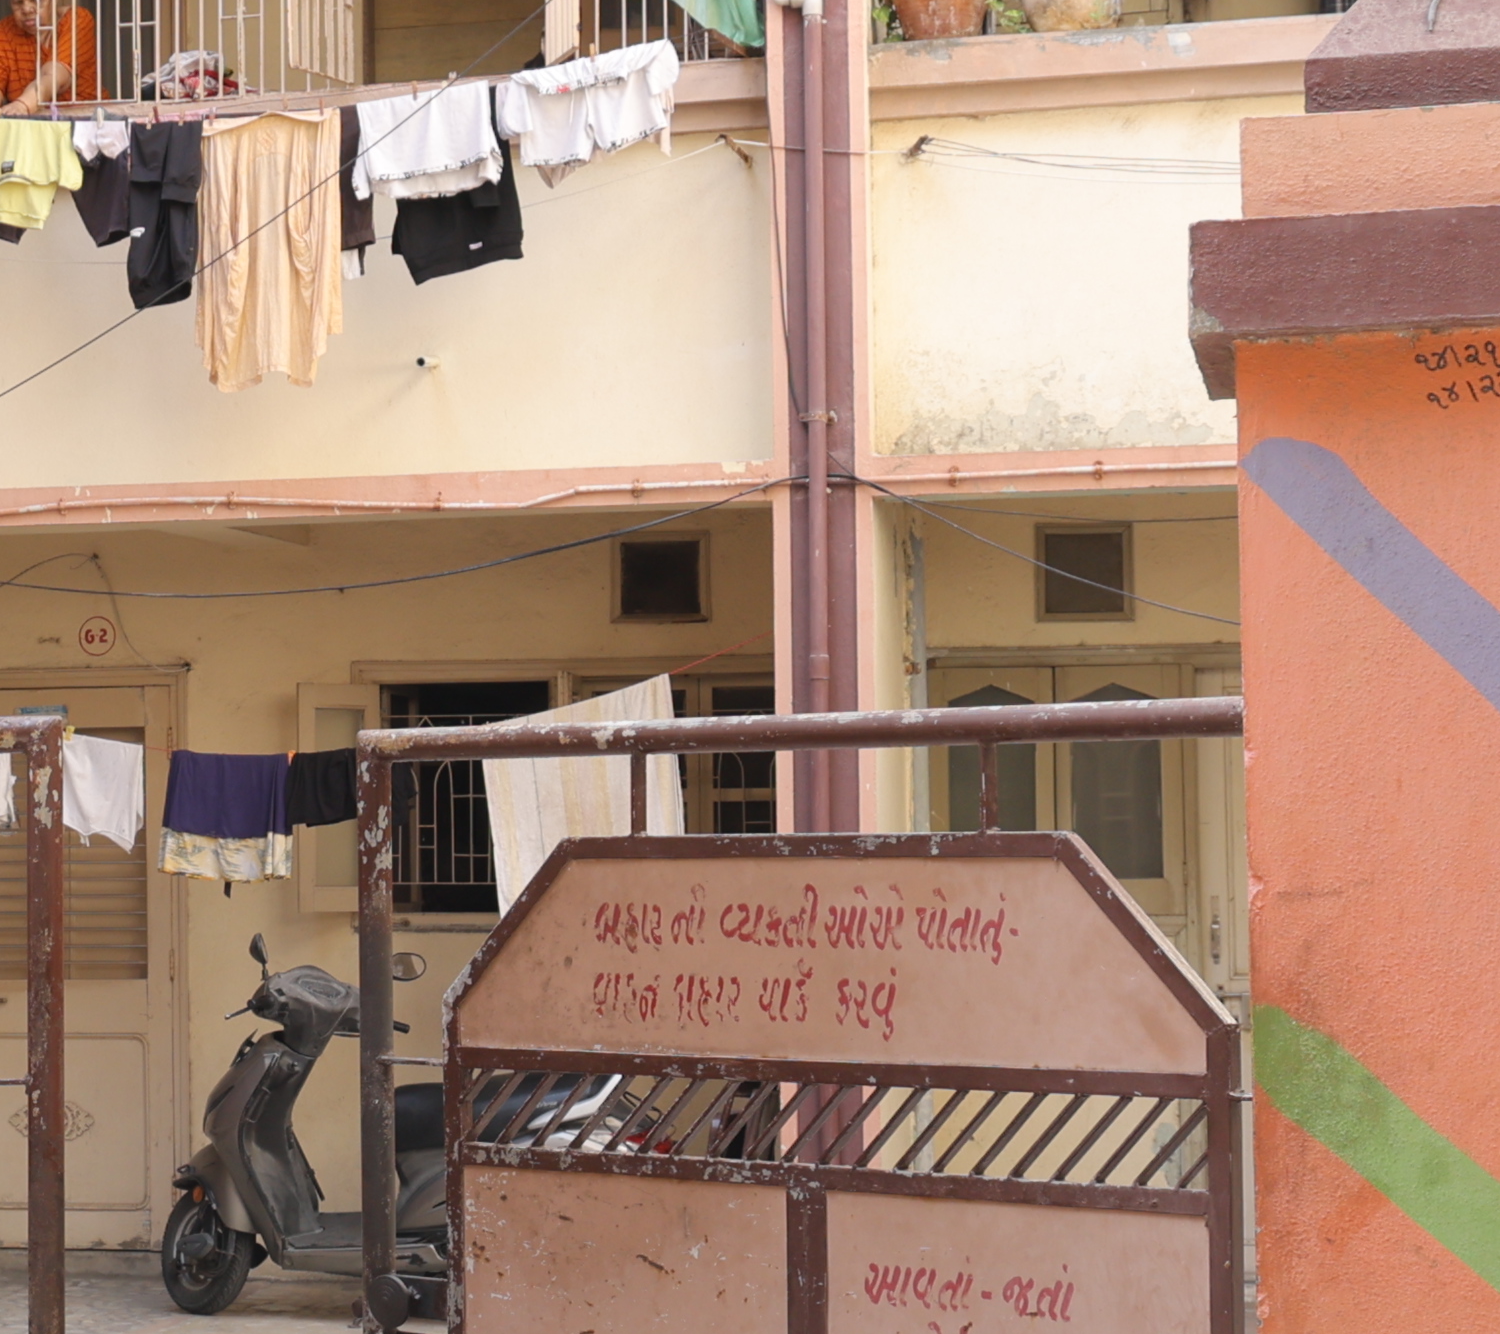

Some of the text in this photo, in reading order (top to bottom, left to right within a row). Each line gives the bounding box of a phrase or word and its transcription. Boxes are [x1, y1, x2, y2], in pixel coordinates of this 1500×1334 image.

[836, 967, 897, 1042] કરવું
[865, 1255, 973, 1312] આવતાં
[1002, 1263, 1075, 1322] જતાં
